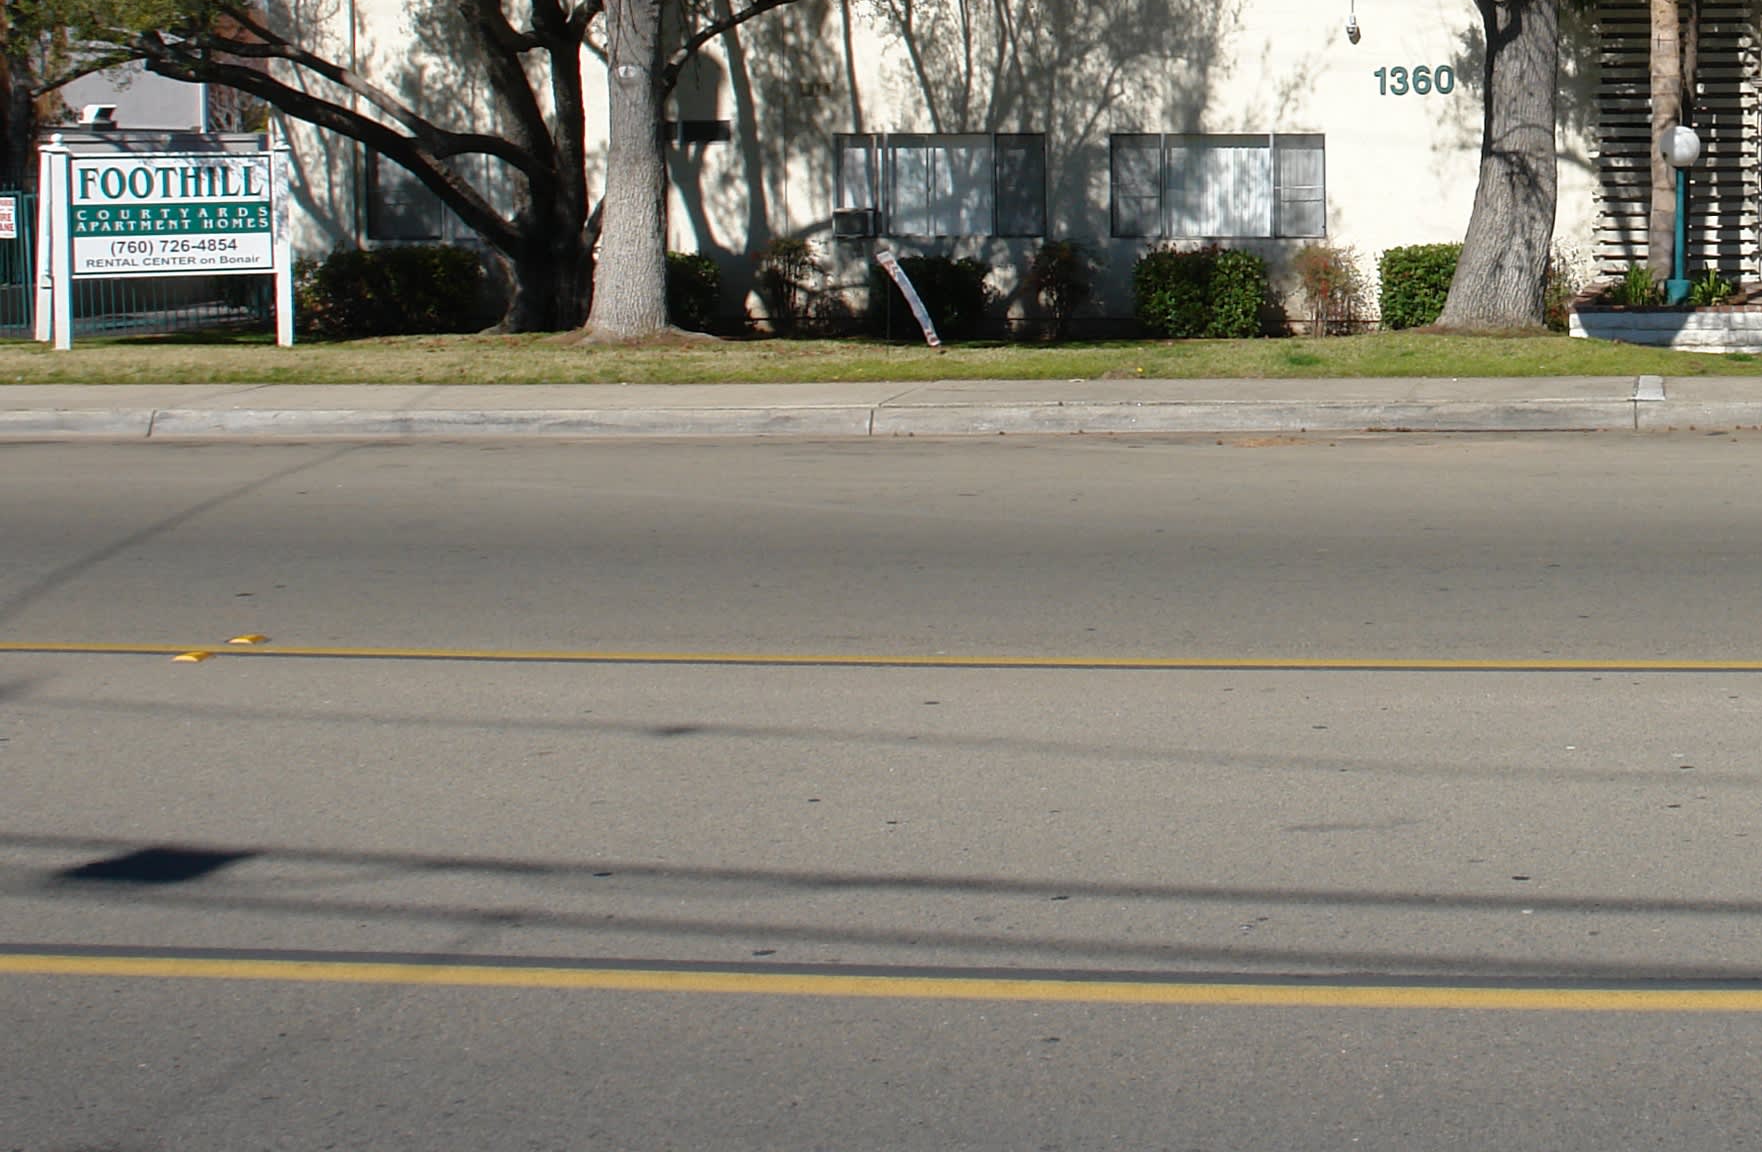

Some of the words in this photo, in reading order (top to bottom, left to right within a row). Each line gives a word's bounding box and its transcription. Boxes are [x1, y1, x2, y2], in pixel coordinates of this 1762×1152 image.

[1374, 65, 1455, 96] 1360
[78, 166, 263, 199] FOOTHILL
[76, 207, 268, 221] COURTYARDS
[76, 219, 191, 232] APARTMENT
[203, 218, 269, 229] HOMES
[111, 240, 154, 257] (760)
[159, 238, 238, 253] 726-4854
[86, 258, 139, 268] RENTAL
[142, 256, 197, 266] CENTER
[199, 256, 216, 264] on
[219, 255, 260, 264] Bonair
